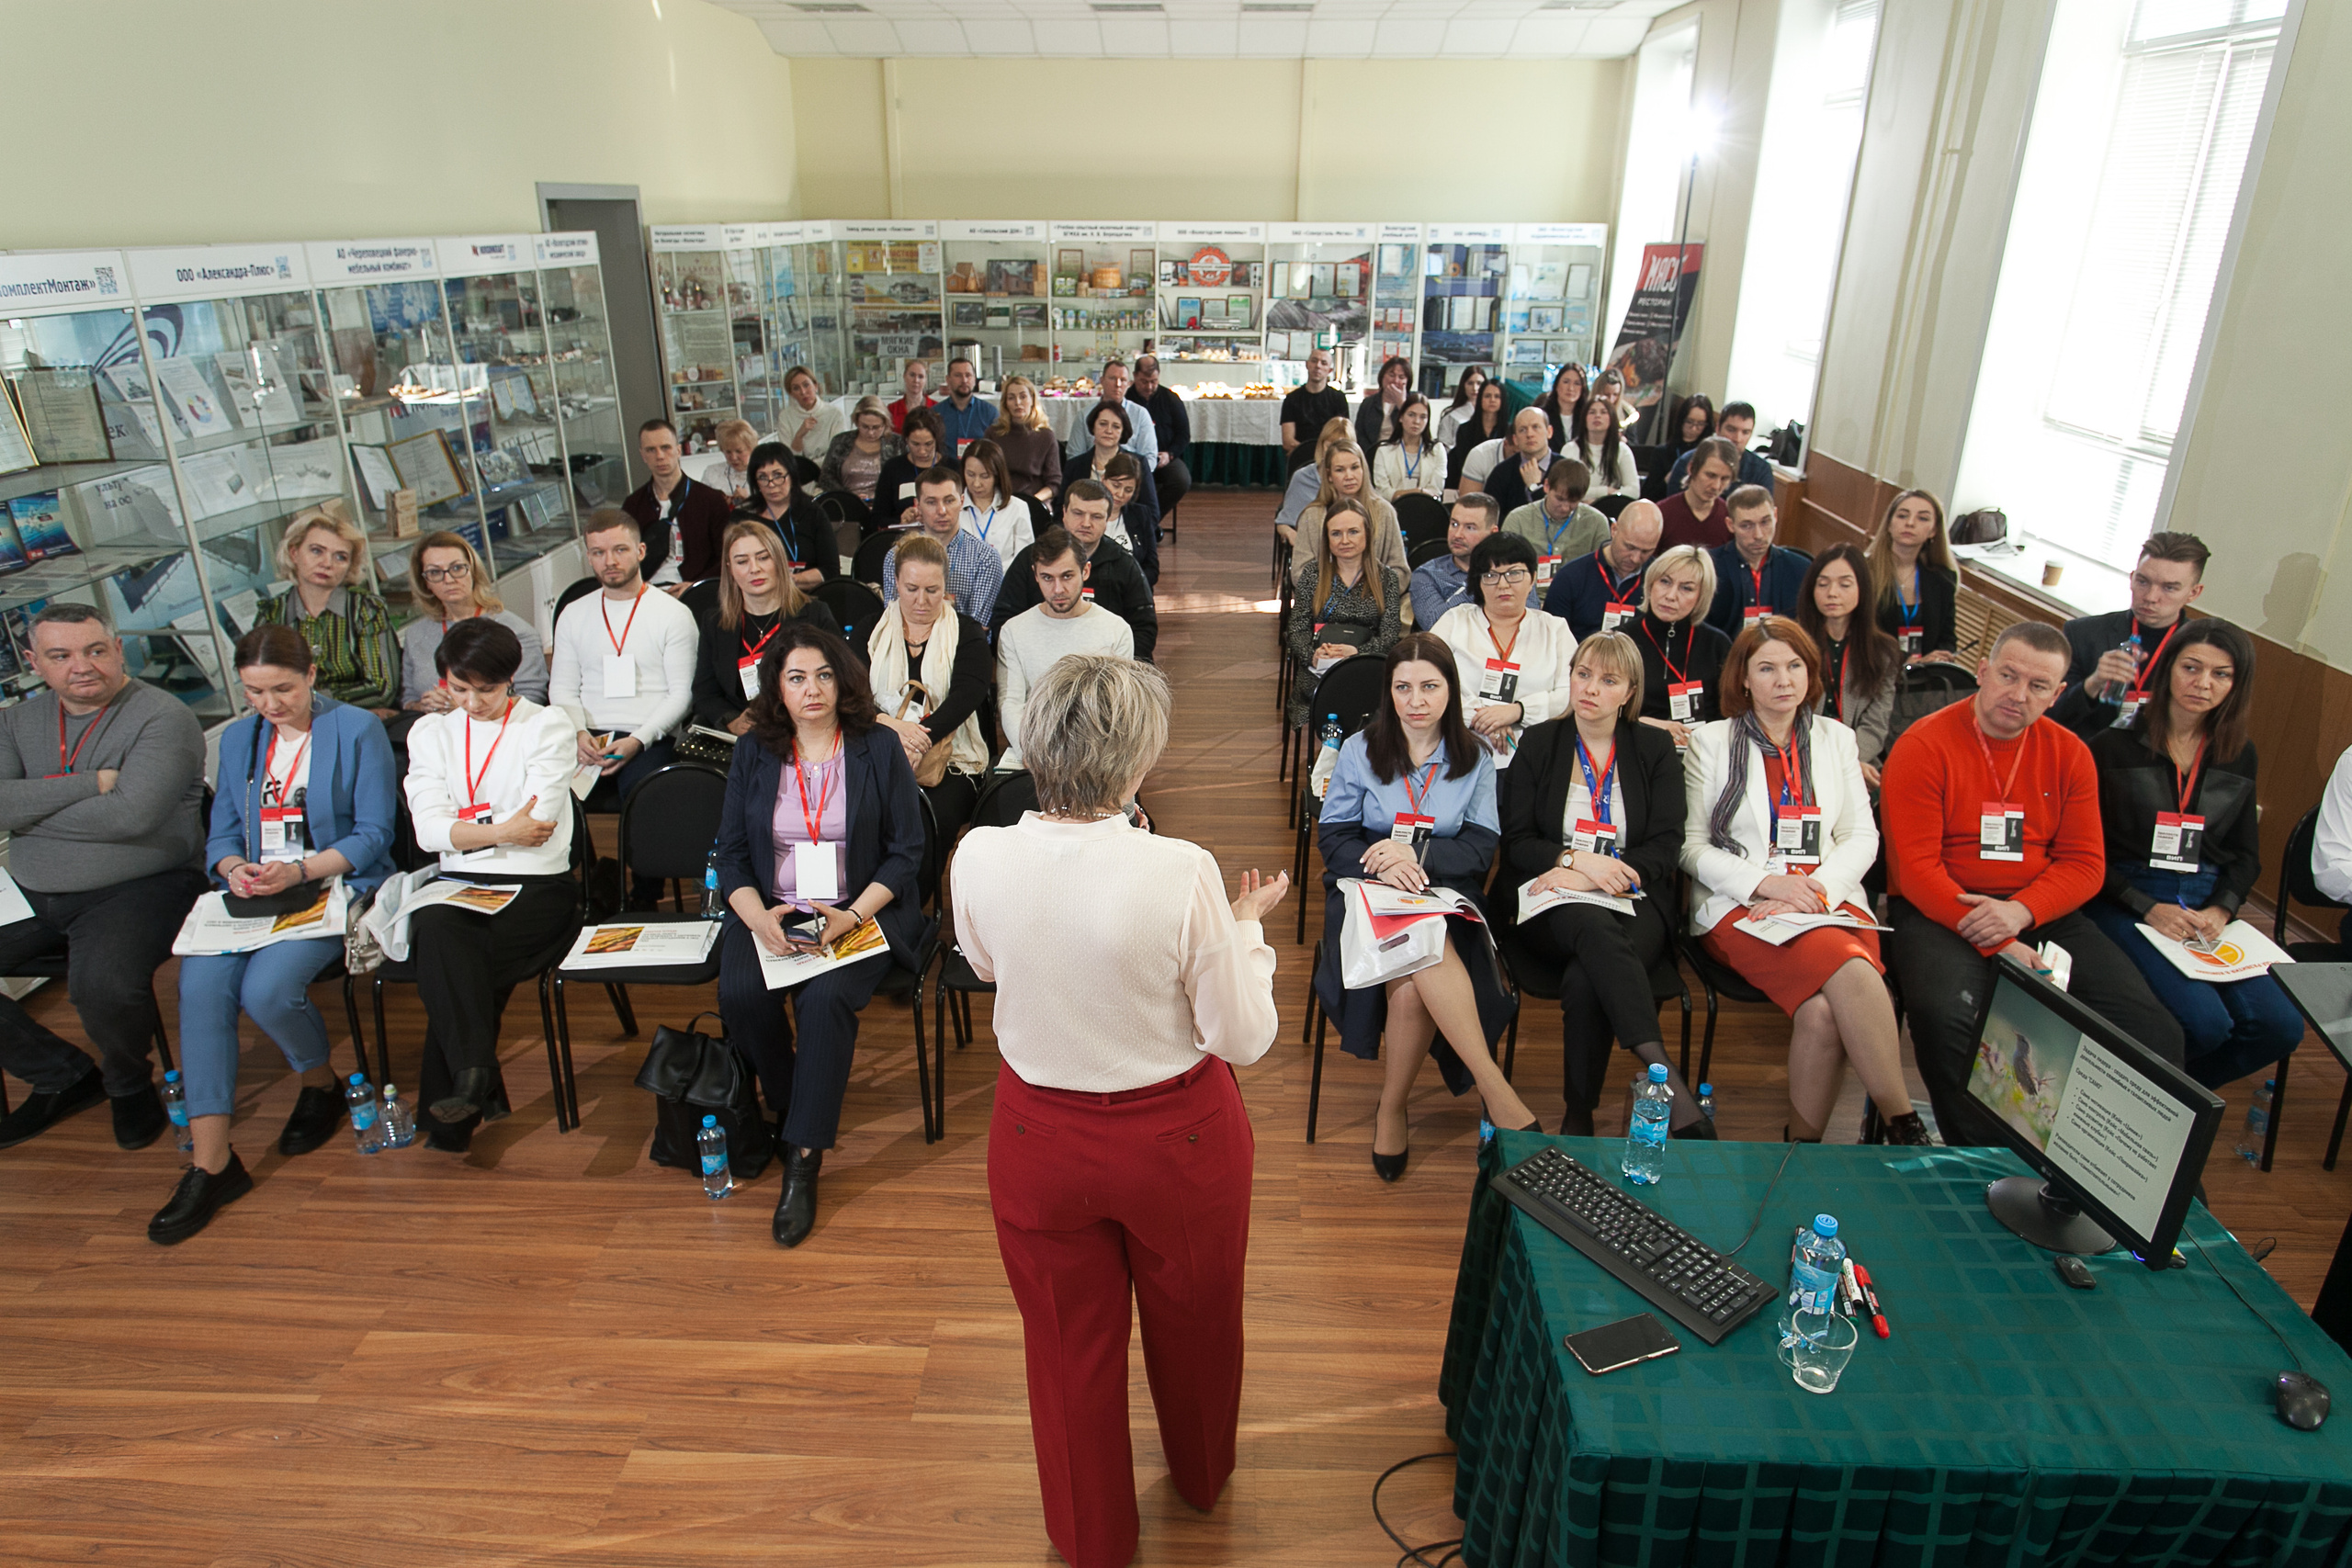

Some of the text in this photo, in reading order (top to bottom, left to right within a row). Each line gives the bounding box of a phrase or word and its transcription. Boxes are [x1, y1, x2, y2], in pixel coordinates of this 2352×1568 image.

[176, 267, 195, 283] ООО
[881, 335, 915, 346] МЯГКИЕ
[887, 344, 910, 355] ОКНА
[2165, 854, 2184, 863] ВИП
[2082, 1044, 2097, 1059] Задача
[2096, 1055, 2111, 1070] лидера
[2113, 1067, 2129, 1083] создать
[2129, 1078, 2142, 1092] среду
